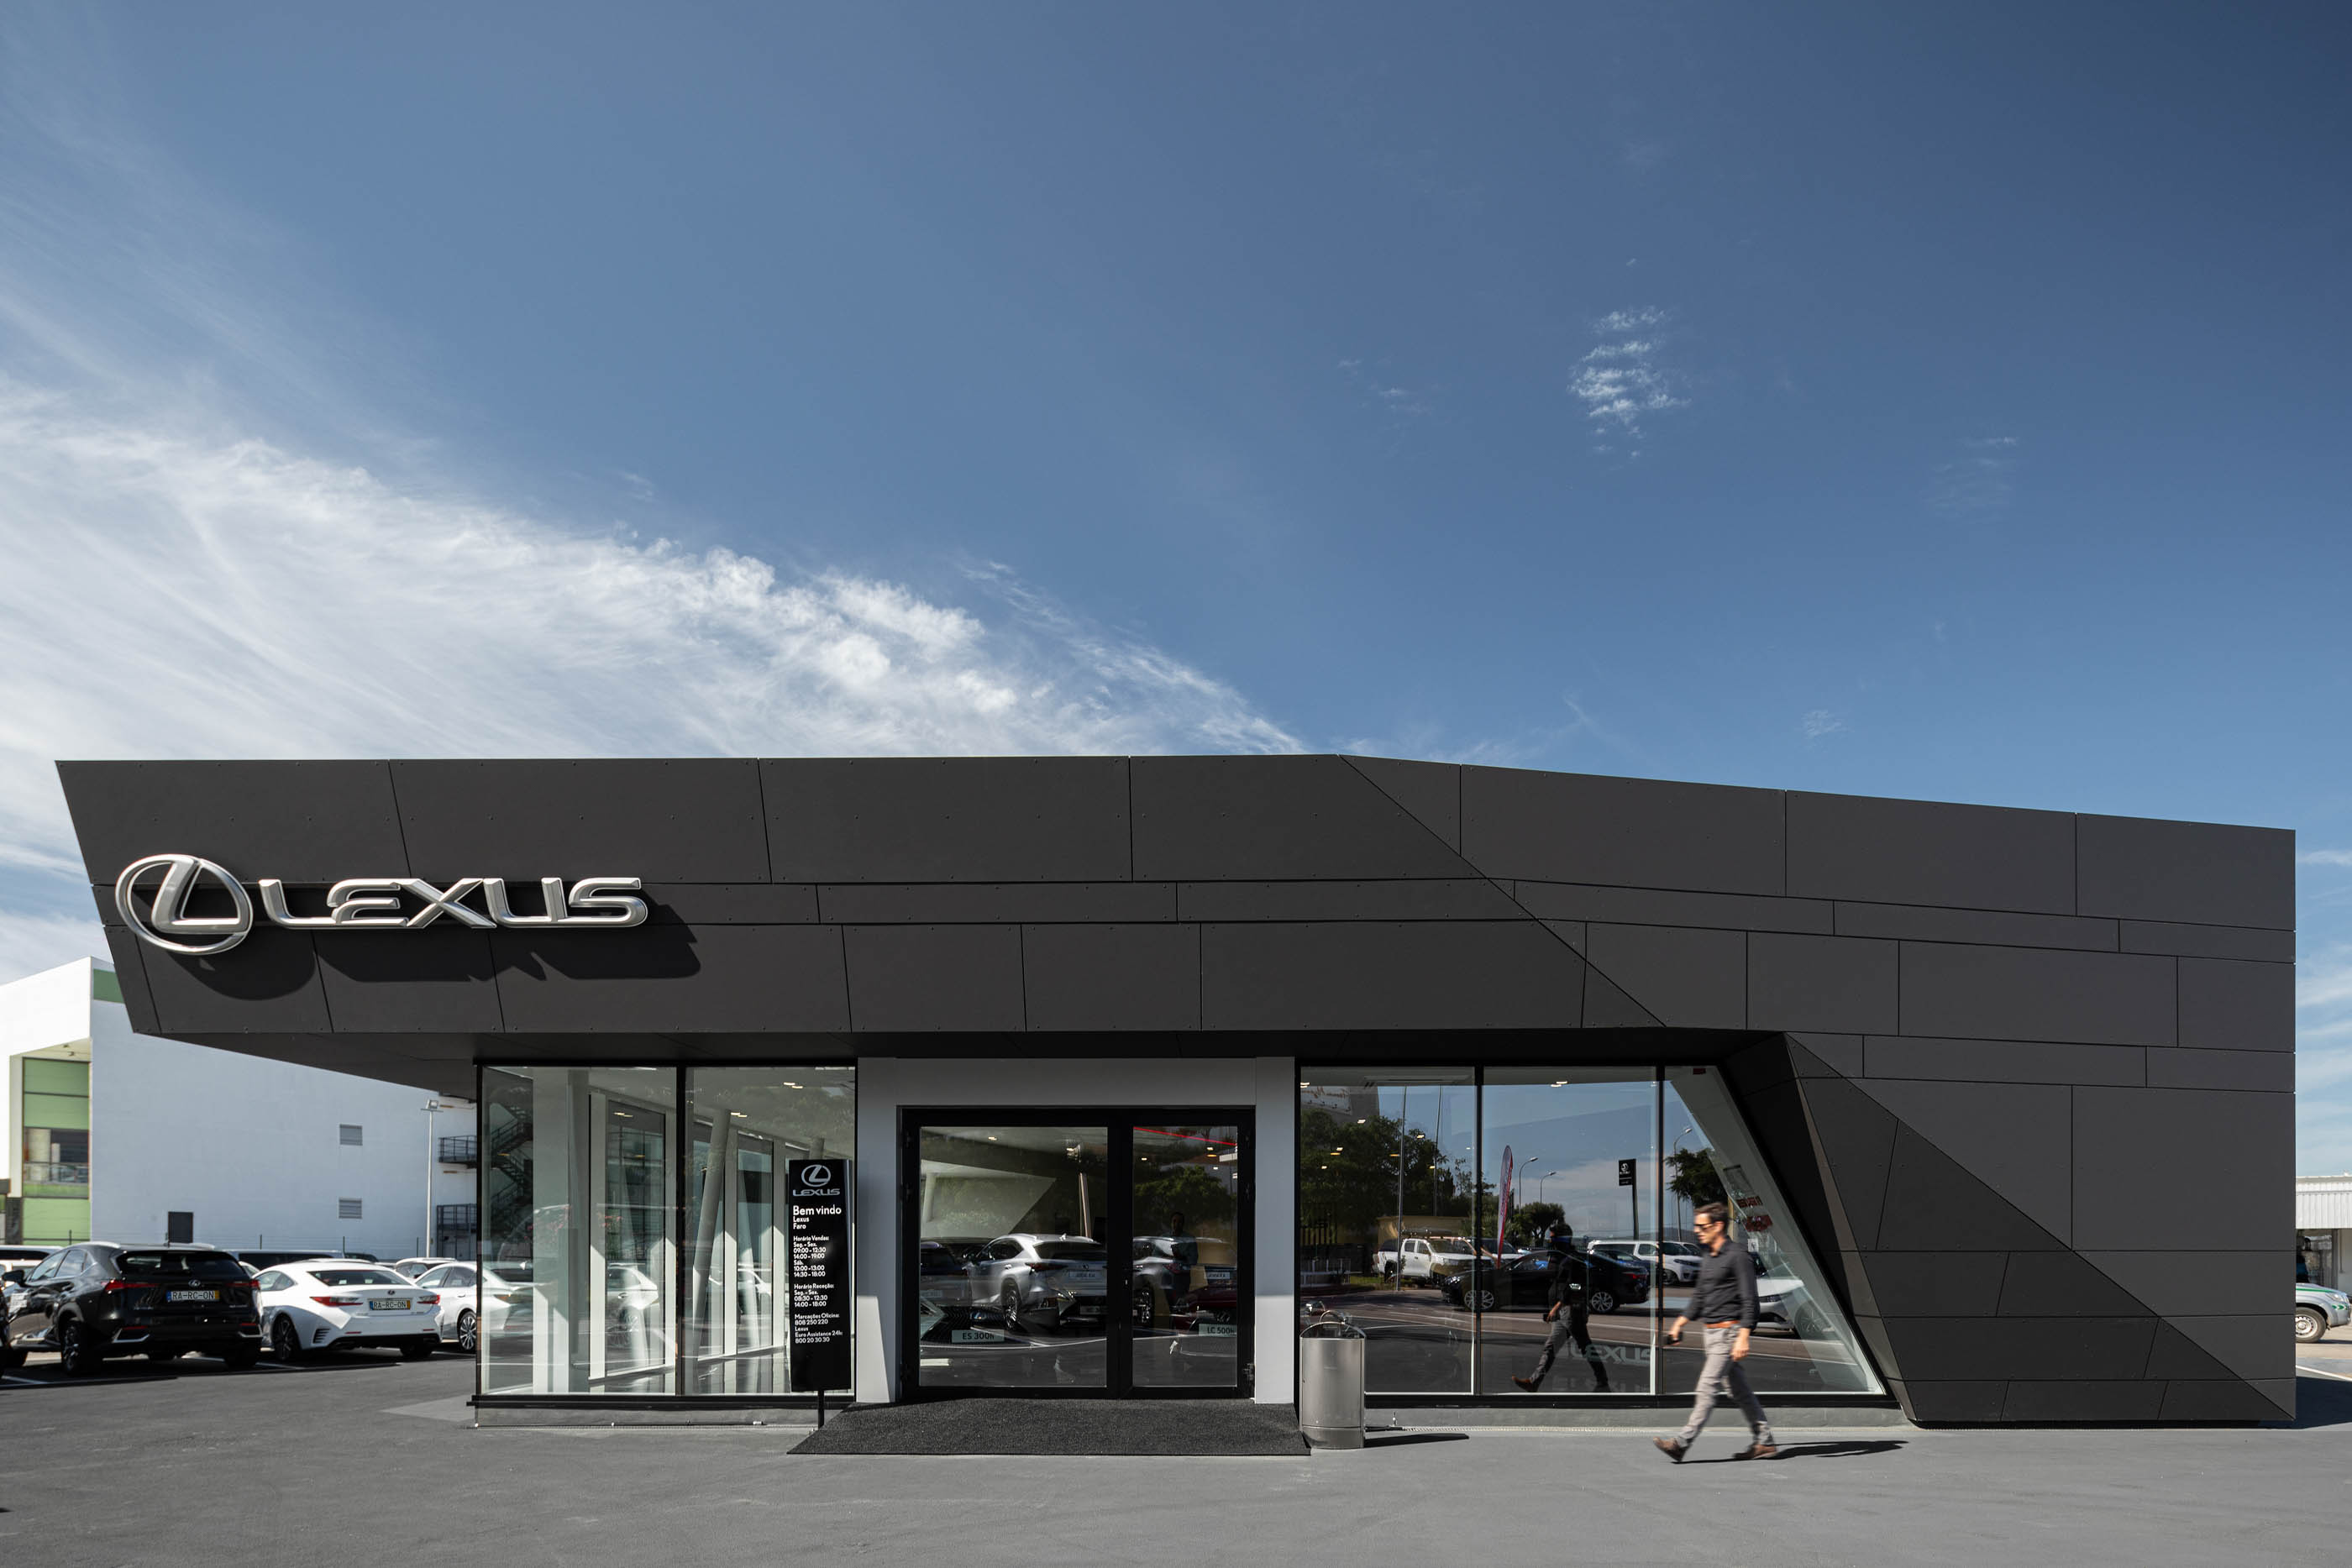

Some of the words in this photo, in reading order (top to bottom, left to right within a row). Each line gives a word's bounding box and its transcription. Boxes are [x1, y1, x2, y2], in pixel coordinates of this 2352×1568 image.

[258, 878, 648, 929] LEXUS
[792, 1188, 841, 1197] LEXUS
[793, 1205, 815, 1215] Bem
[816, 1204, 842, 1215] vindo
